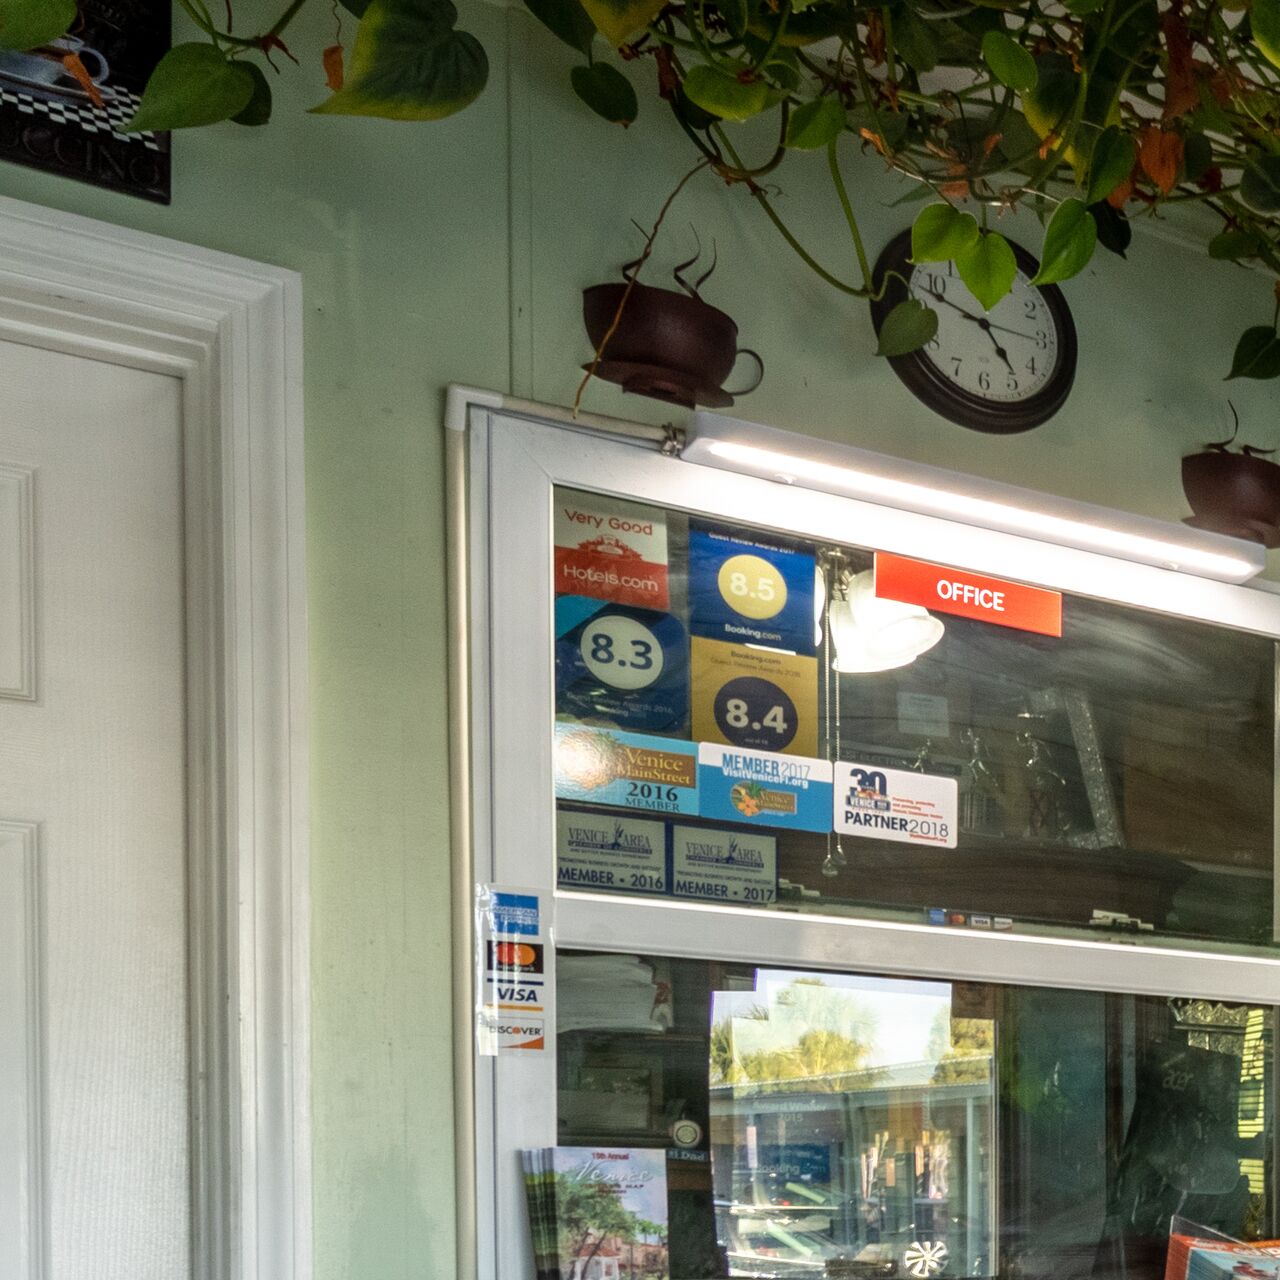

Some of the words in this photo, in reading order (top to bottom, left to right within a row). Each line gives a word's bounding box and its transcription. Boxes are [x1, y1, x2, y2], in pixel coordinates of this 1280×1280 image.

[1024, 301, 1036, 320] 2
[951, 357, 963, 376] 7
[1025, 356, 1035, 375] 4
[979, 372, 990, 391] 6
[1007, 371, 1018, 391] 5
[565, 509, 604, 527] Very
[609, 518, 653, 535] Good
[563, 564, 658, 592] Hotels.com
[729, 572, 775, 601] 8.5
[936, 579, 1005, 612] OFFICE
[724, 624, 781, 641] Booking.com
[591, 633, 653, 670] 8.3
[726, 698, 787, 735] 8.4
[624, 748, 684, 772] Venice
[722, 753, 780, 776] MEMBER
[780, 761, 811, 779] 2017
[616, 763, 690, 785] MainStreet
[627, 782, 679, 801] 2016
[624, 797, 681, 813] MEMBER
[845, 811, 909, 832] PARTNER
[909, 818, 950, 838] 2018
[568, 827, 609, 843] VENICE
[624, 835, 651, 847] AREA
[686, 841, 724, 857] VENICE
[737, 847, 763, 863] AREA
[557, 867, 614, 885] MEMBER
[631, 874, 664, 890] 2016
[675, 879, 729, 897] MEMBER
[743, 886, 775, 901] 2017
[497, 987, 538, 1002] VISA
